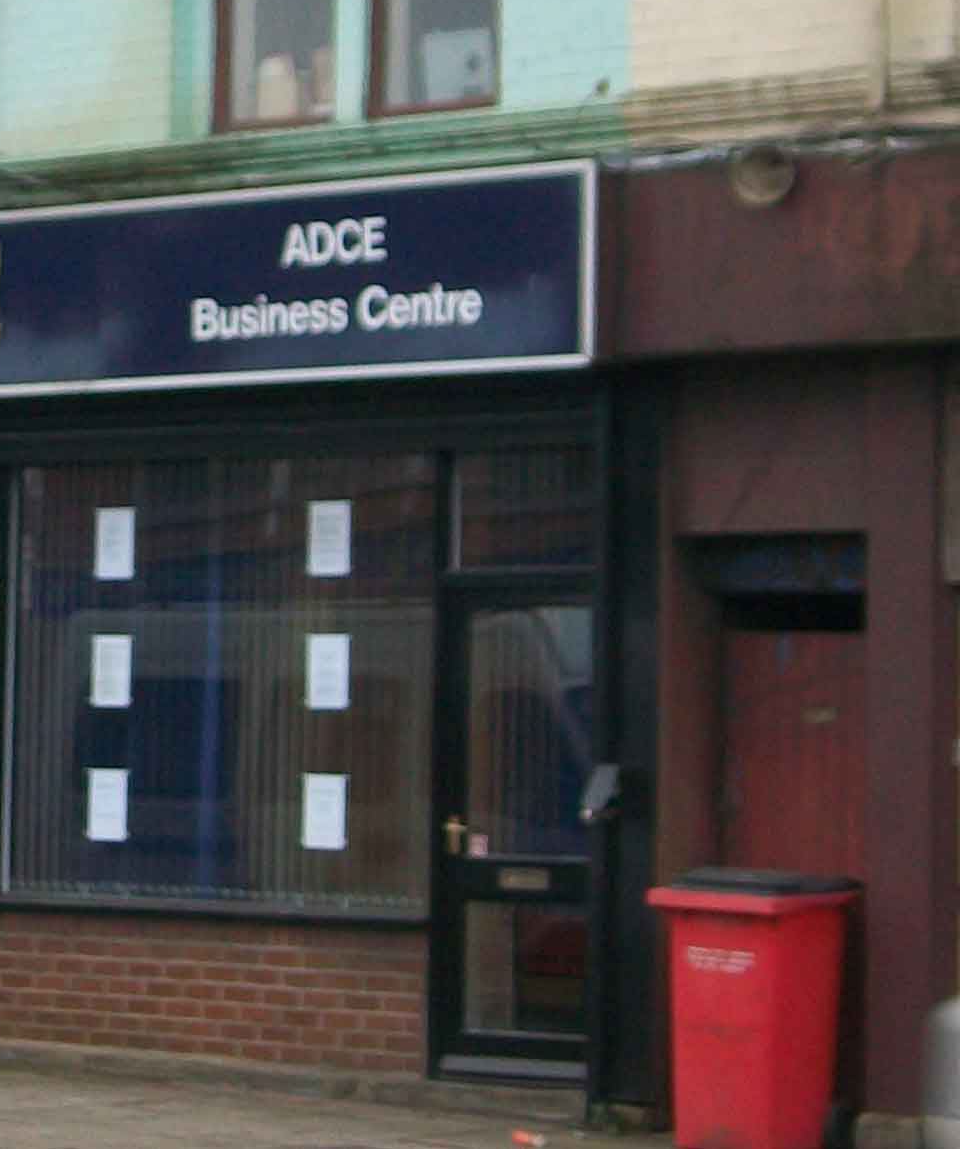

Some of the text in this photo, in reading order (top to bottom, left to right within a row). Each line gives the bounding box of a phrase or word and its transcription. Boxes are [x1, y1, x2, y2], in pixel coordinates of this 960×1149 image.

[280, 215, 388, 269] ADCE
[191, 282, 483, 342] Business Centre
